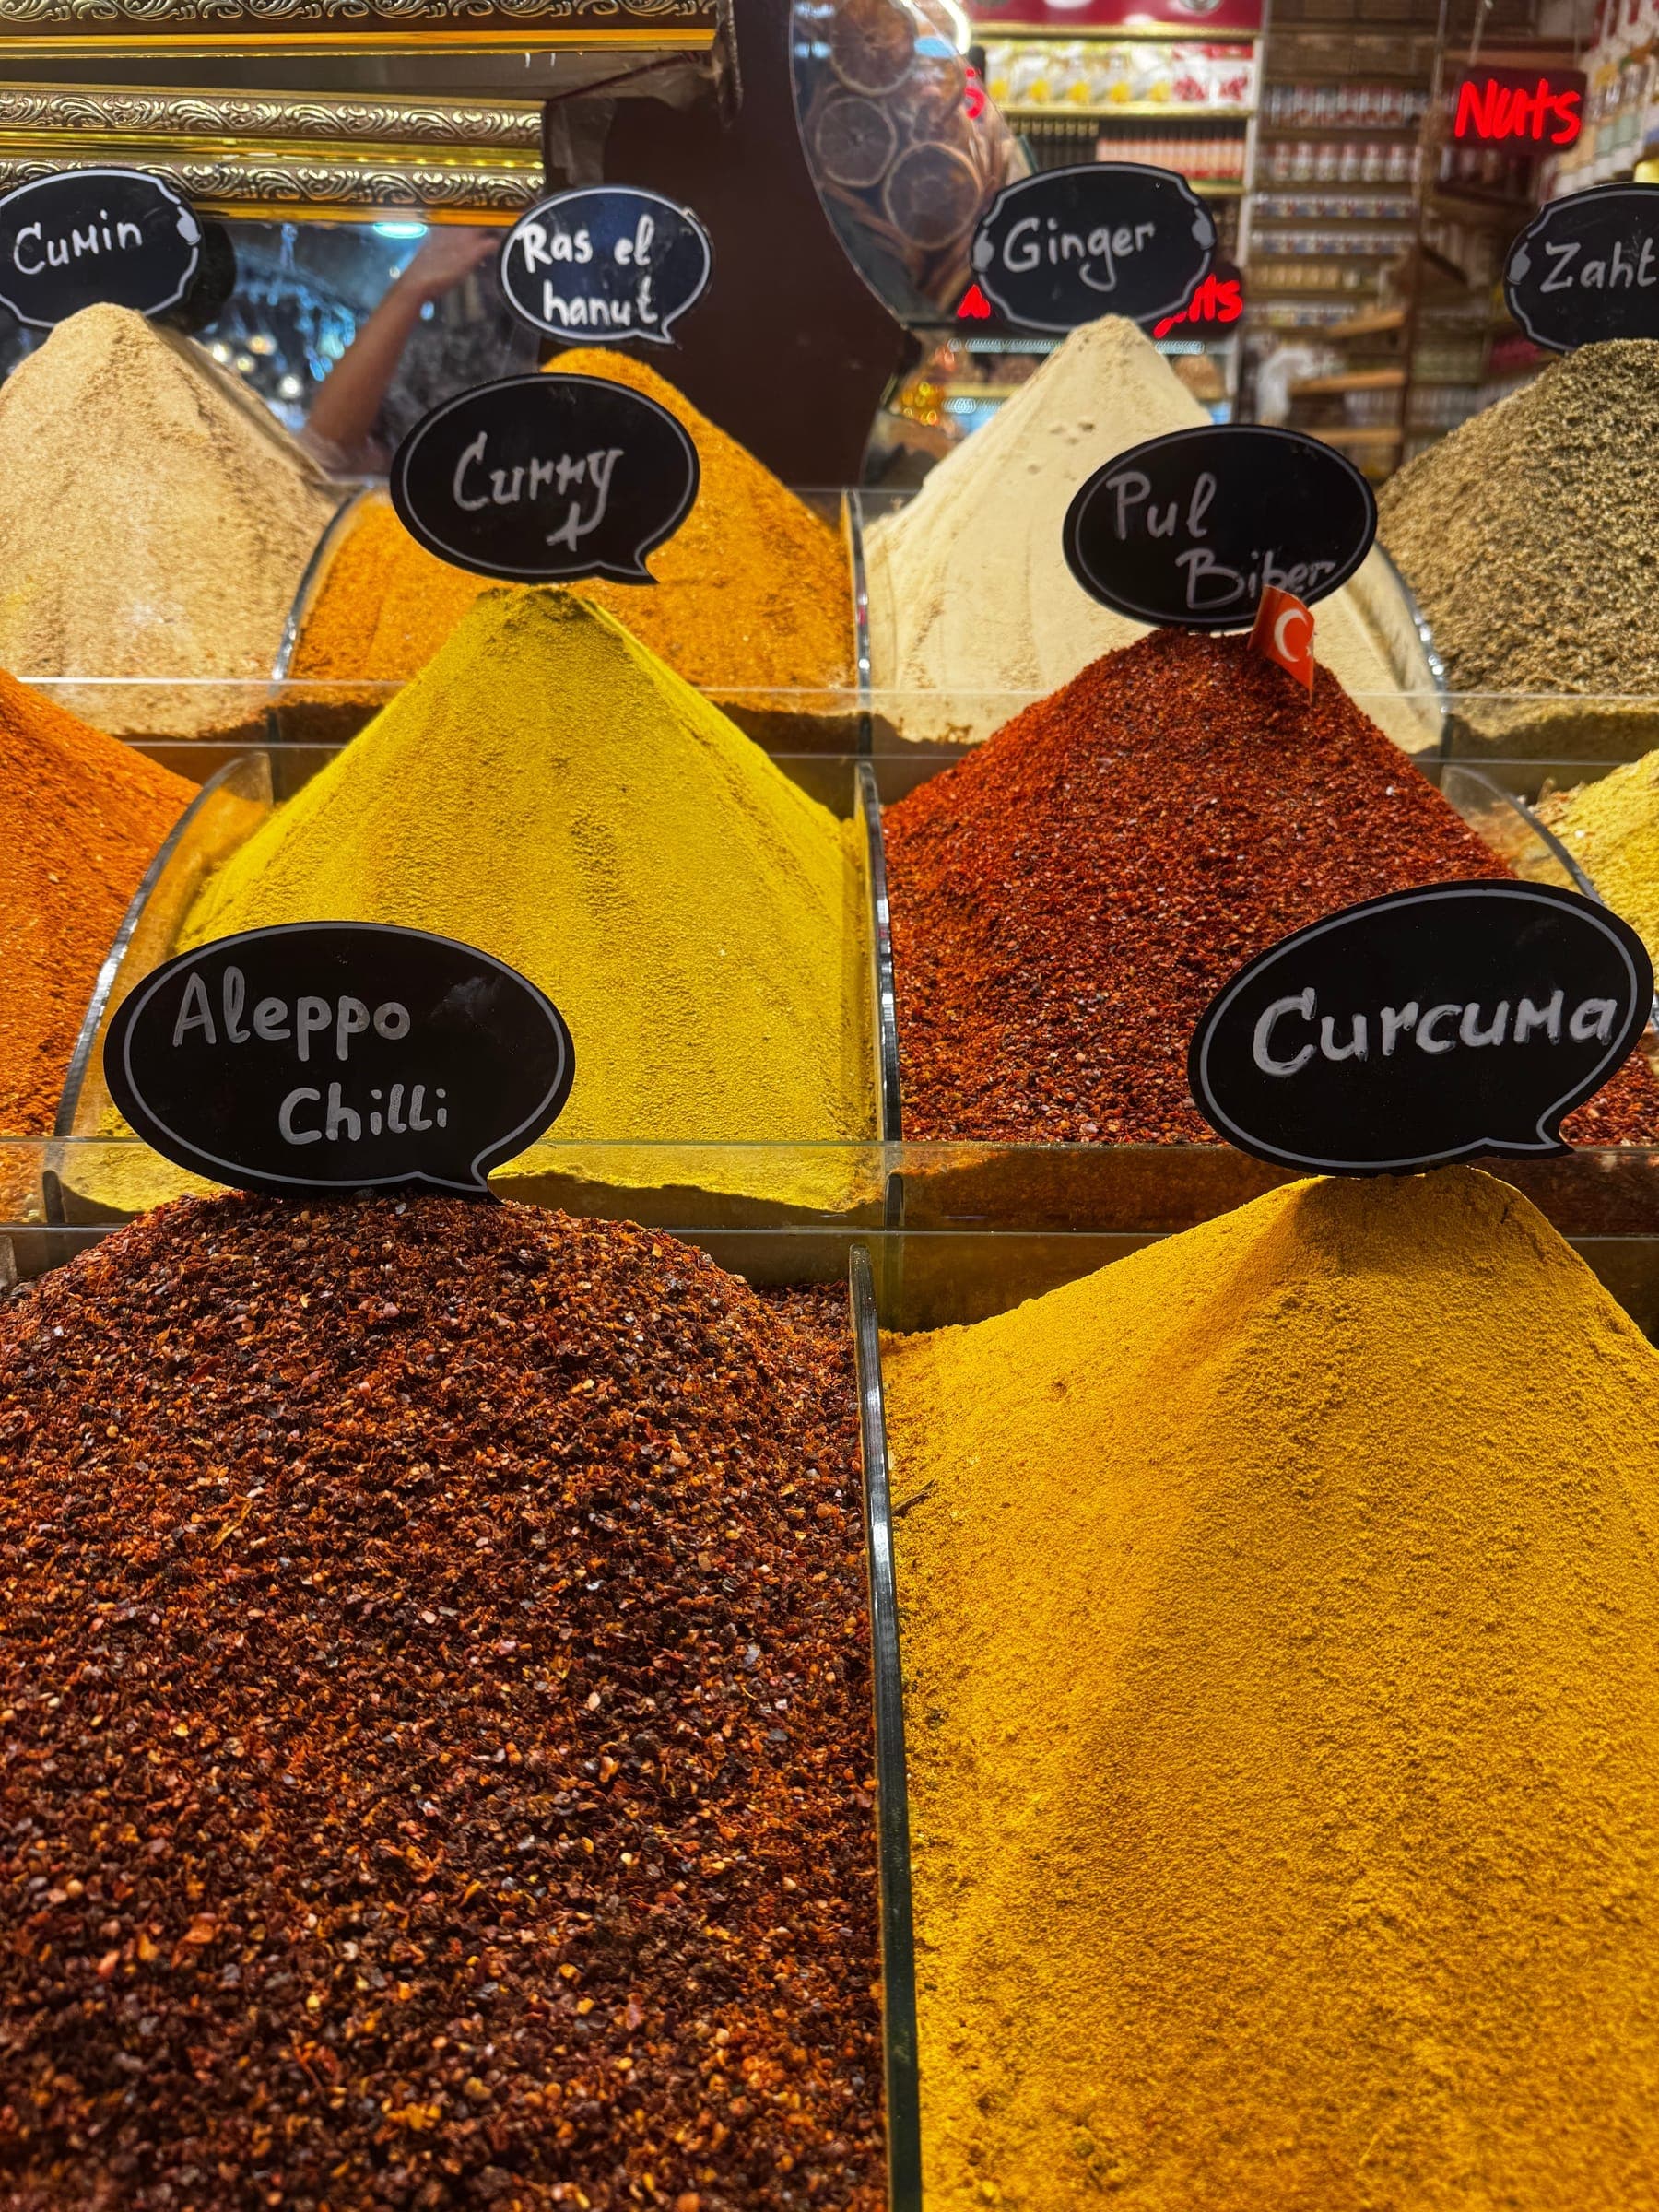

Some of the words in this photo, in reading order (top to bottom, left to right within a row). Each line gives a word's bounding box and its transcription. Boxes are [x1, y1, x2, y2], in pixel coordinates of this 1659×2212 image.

[1454, 78, 1582, 145] Nuts
[516, 223, 593, 273] Ras
[614, 214, 654, 265] el
[1003, 218, 1156, 291] Ginger
[543, 276, 658, 326] hanut
[453, 431, 624, 552] Curry
[1106, 471, 1217, 540] Pul
[1175, 547, 1335, 609] Biber
[172, 966, 411, 1062] Aleppo
[279, 1082, 448, 1145] Chilli
